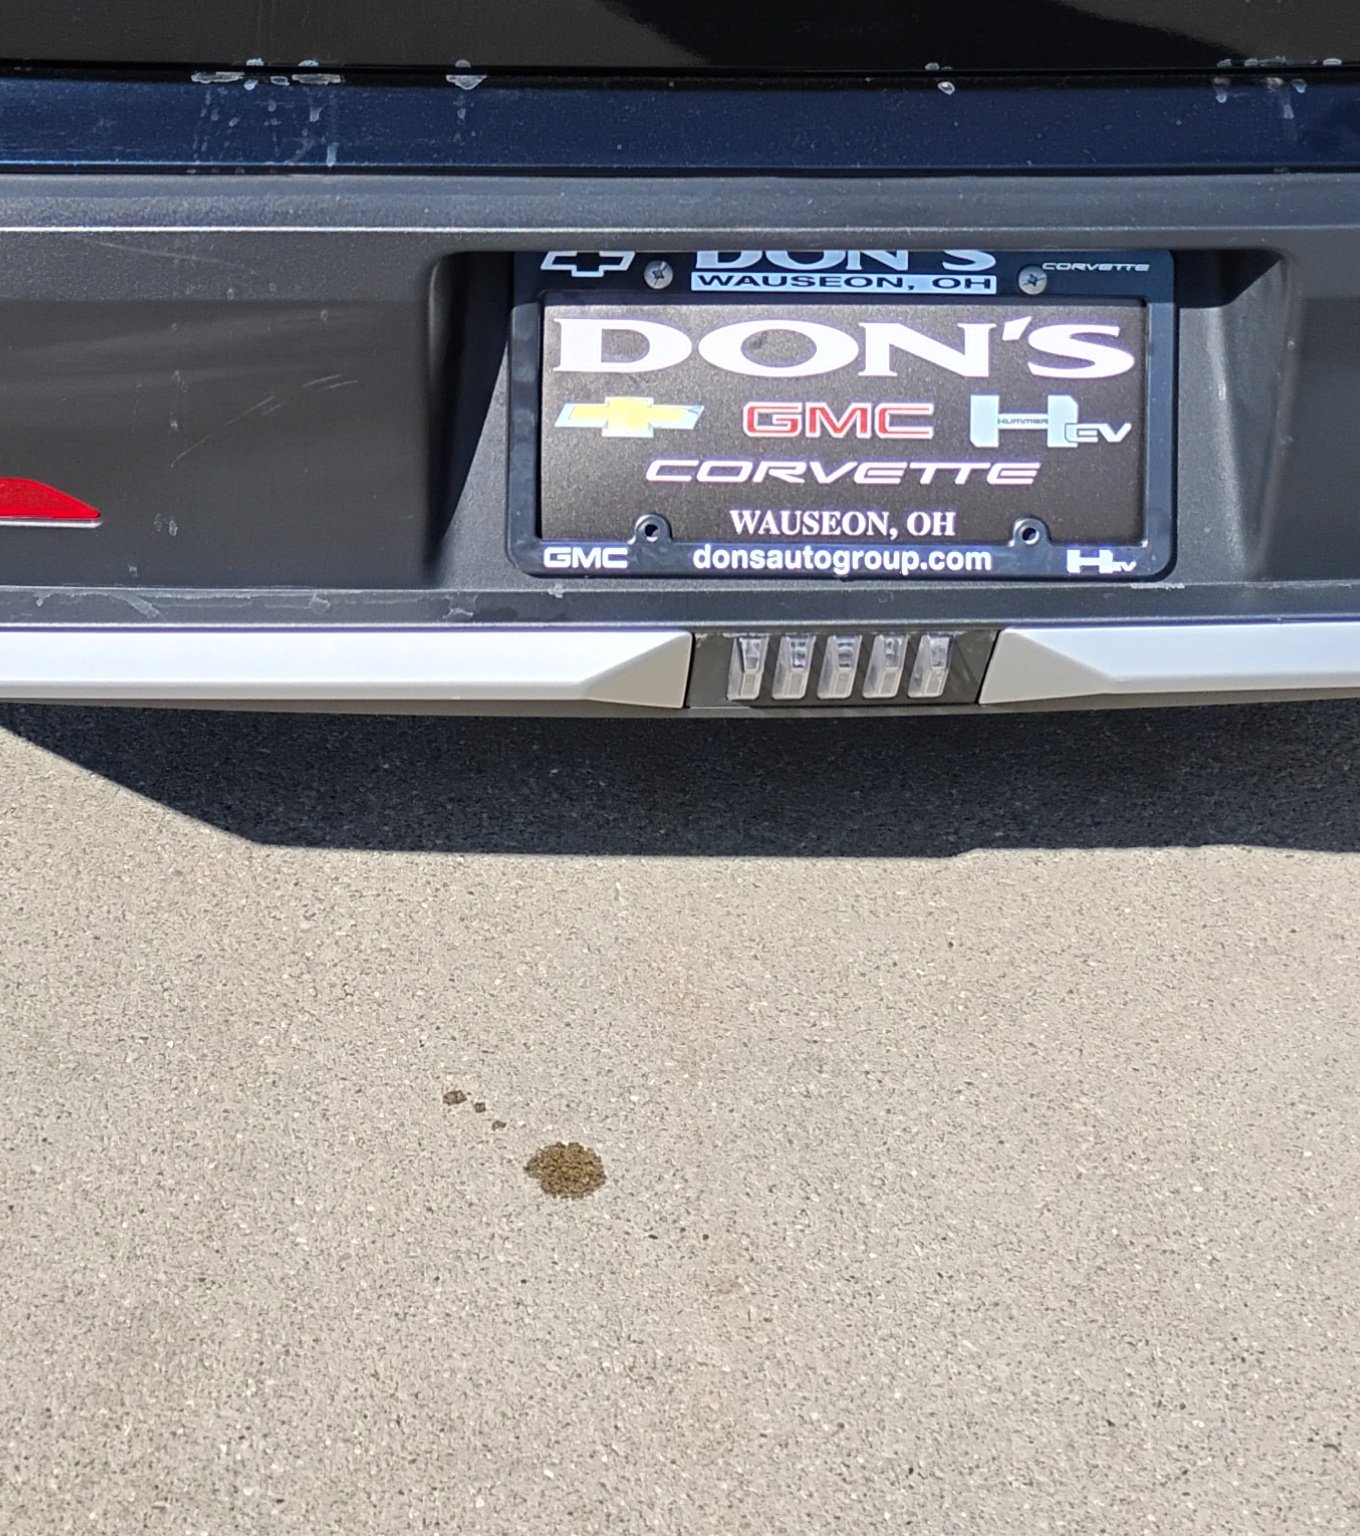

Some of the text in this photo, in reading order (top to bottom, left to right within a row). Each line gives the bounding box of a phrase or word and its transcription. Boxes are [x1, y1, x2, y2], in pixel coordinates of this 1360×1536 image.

[695, 250, 997, 272] DONS
[1042, 262, 1151, 271] CORVETTE
[697, 275, 992, 291] WAUSEON, OH
[553, 315, 1136, 379] DON'S
[742, 401, 934, 440] GMC
[646, 459, 1041, 486] CORVETTE
[729, 509, 956, 540] WAUSEON, OH
[544, 547, 629, 569] GMC
[692, 543, 993, 576] donsautogroup.com
